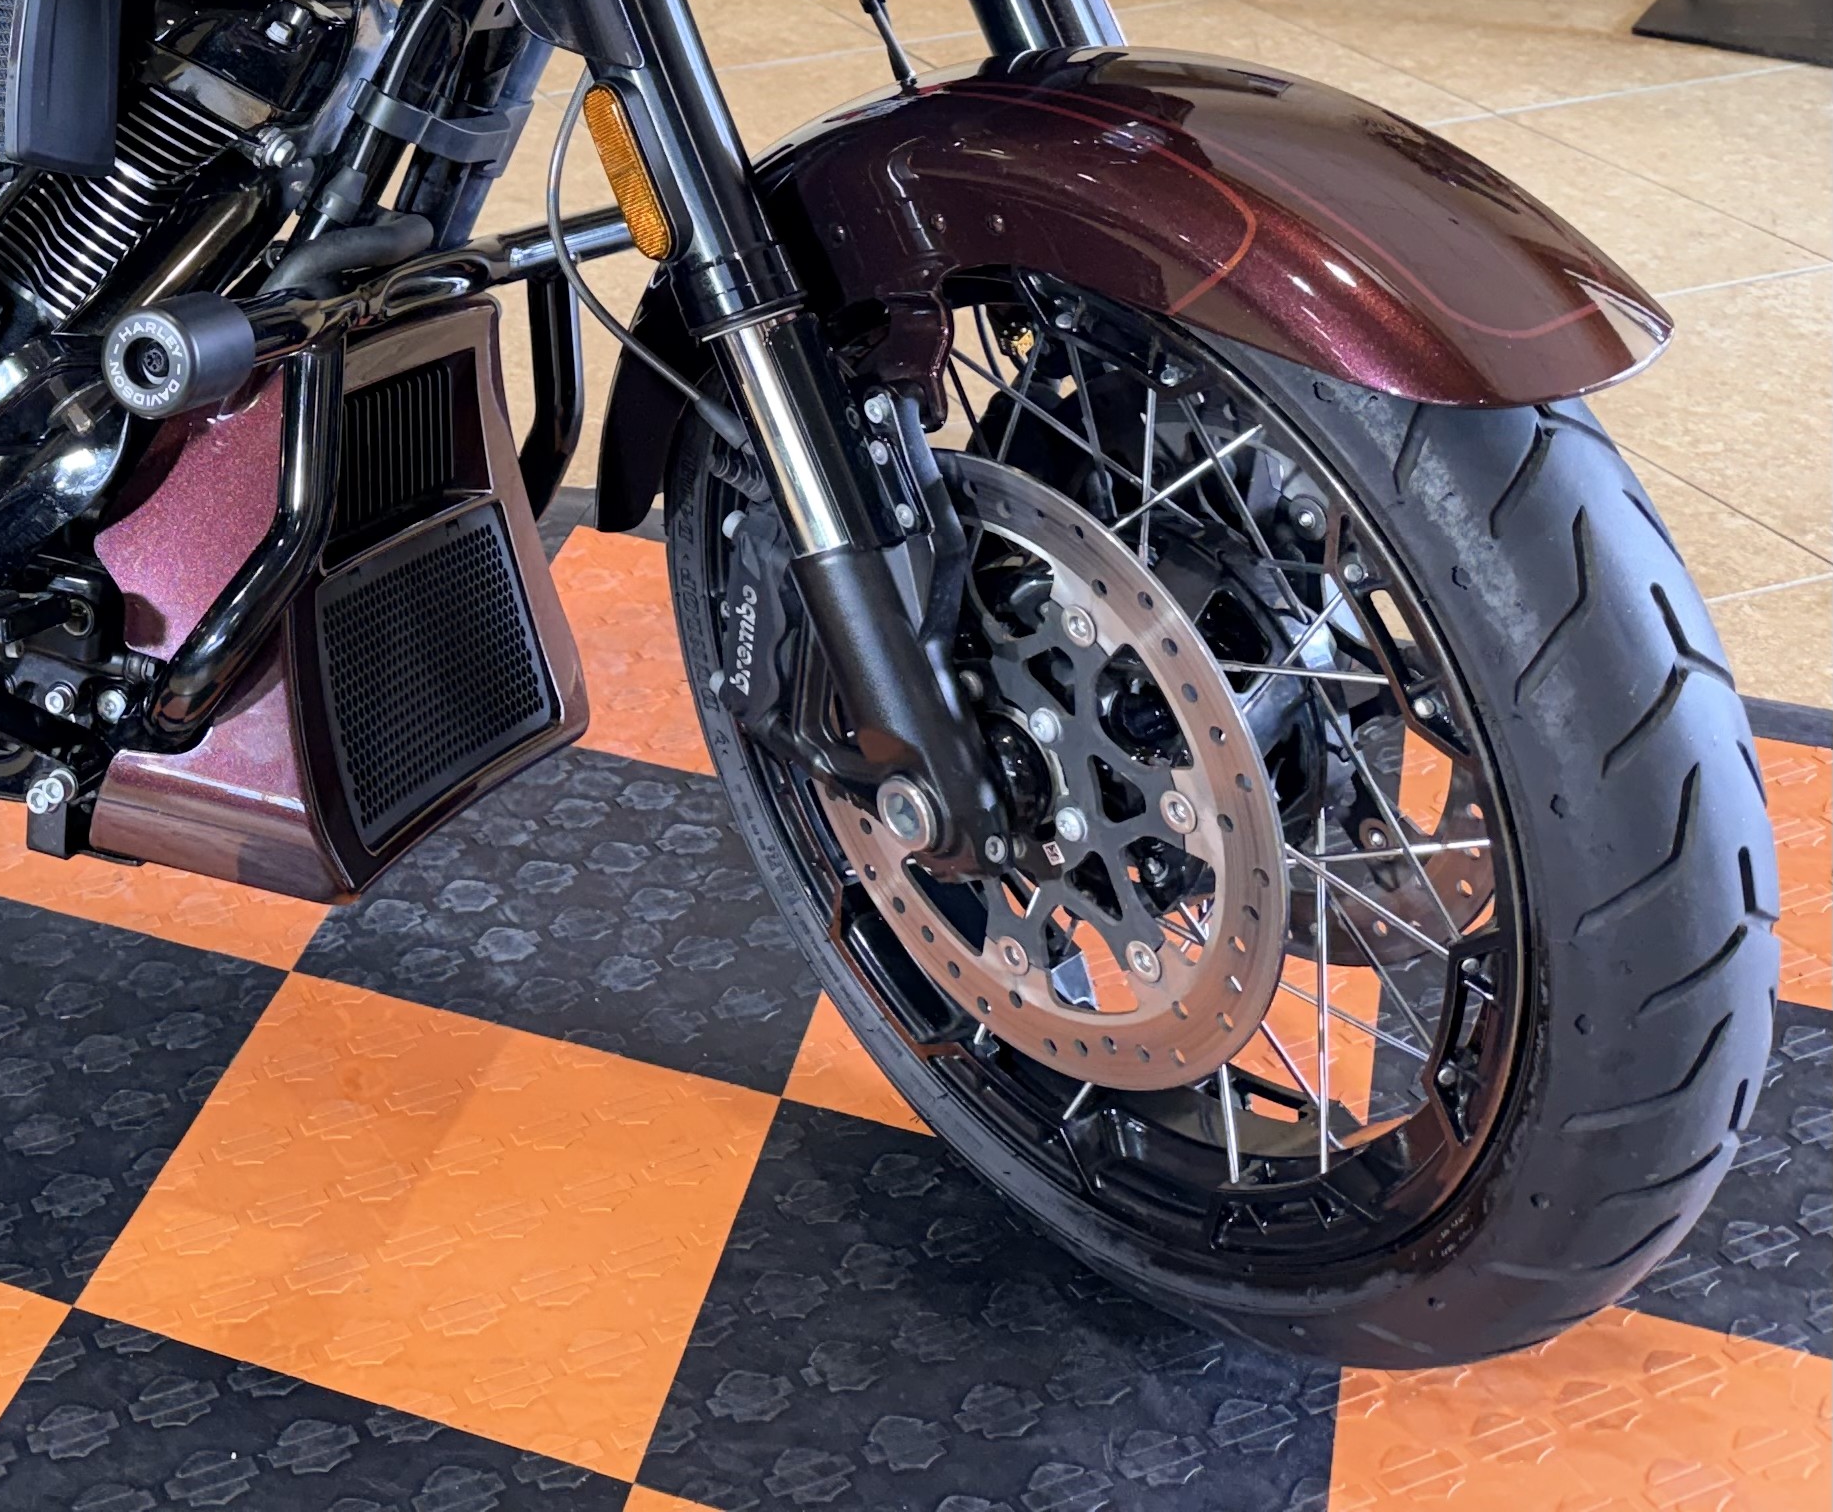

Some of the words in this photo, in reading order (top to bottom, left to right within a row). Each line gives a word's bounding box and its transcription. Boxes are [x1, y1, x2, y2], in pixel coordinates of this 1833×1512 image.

[118, 321, 183, 357] HARLEY
[109, 361, 180, 407] DAVIDSON
[729, 584, 758, 696] brembo
